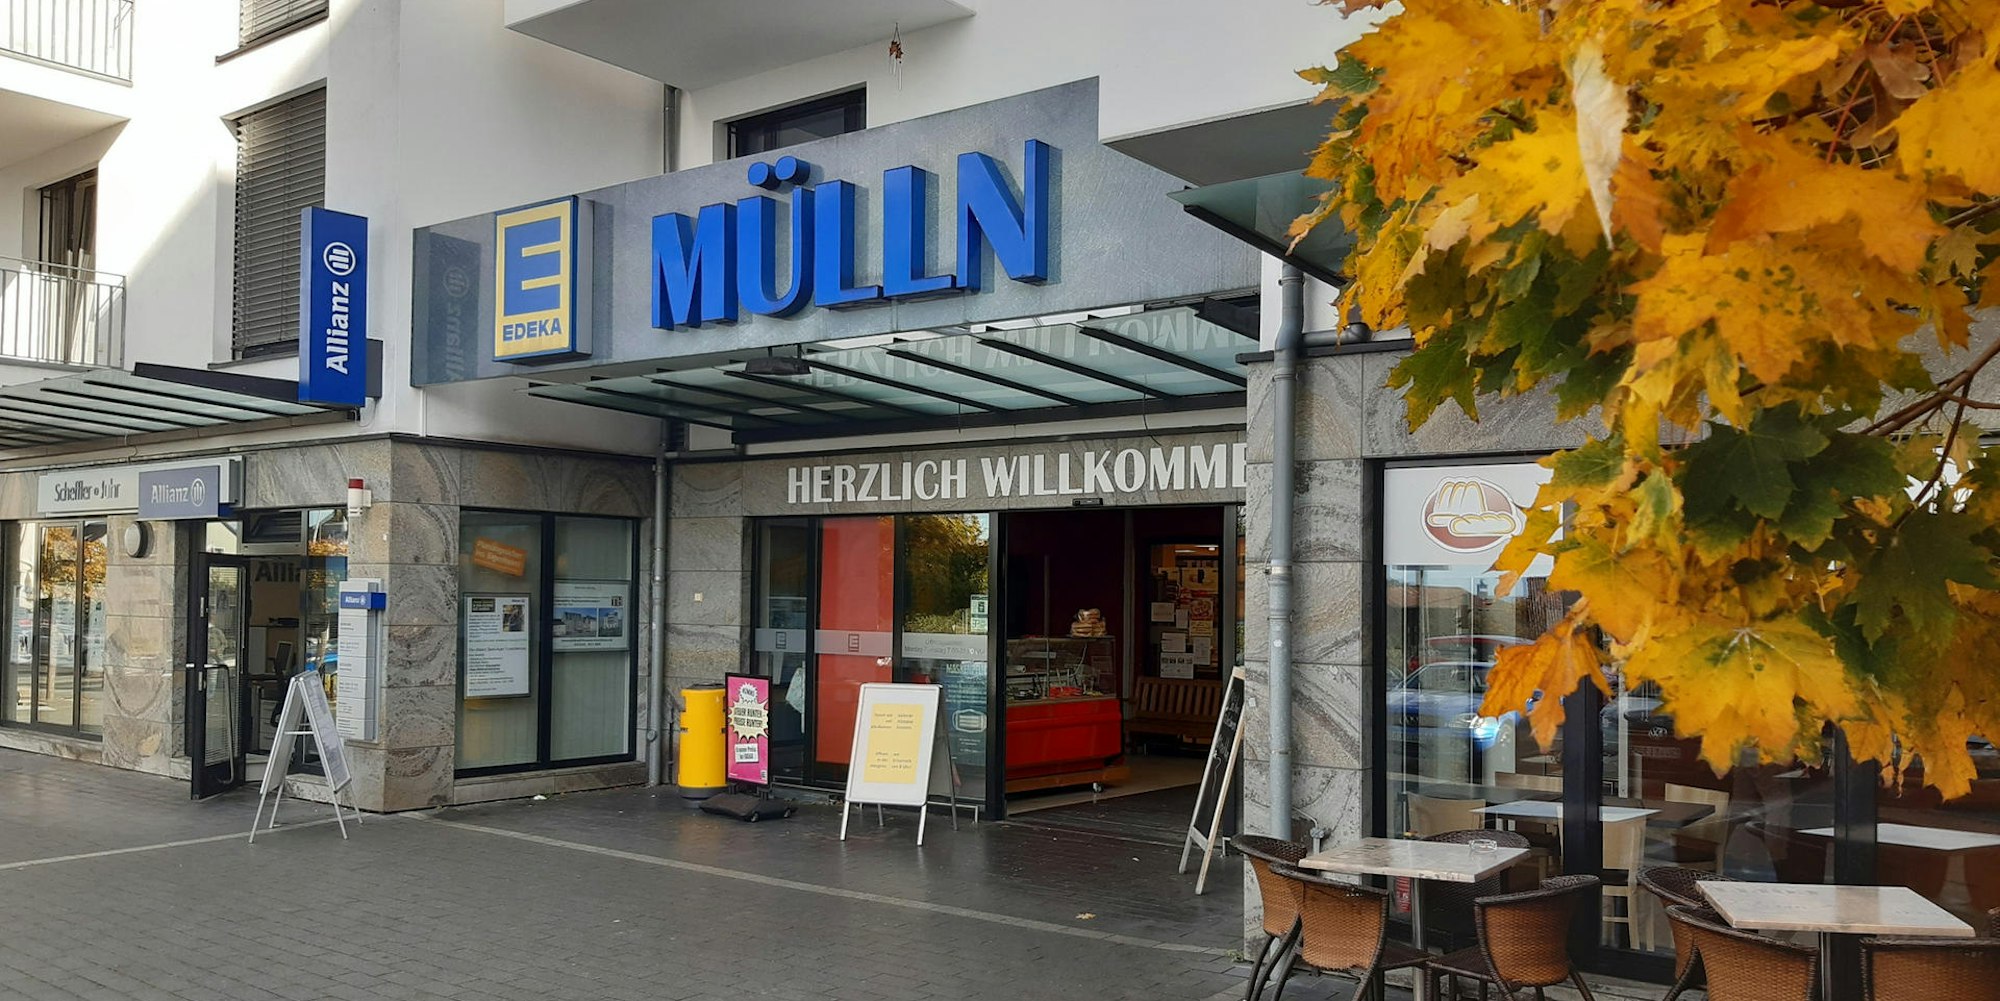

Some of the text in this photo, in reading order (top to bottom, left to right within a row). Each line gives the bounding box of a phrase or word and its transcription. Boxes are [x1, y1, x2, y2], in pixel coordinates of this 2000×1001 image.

[652, 139, 1051, 331] MÜLLN
[503, 216, 562, 317] E
[326, 281, 350, 375] Allianz
[502, 317, 562, 342] EDEKA
[54, 480, 92, 502] Scheffler
[151, 484, 189, 504] Allianz
[787, 458, 967, 503] HERZLICH
